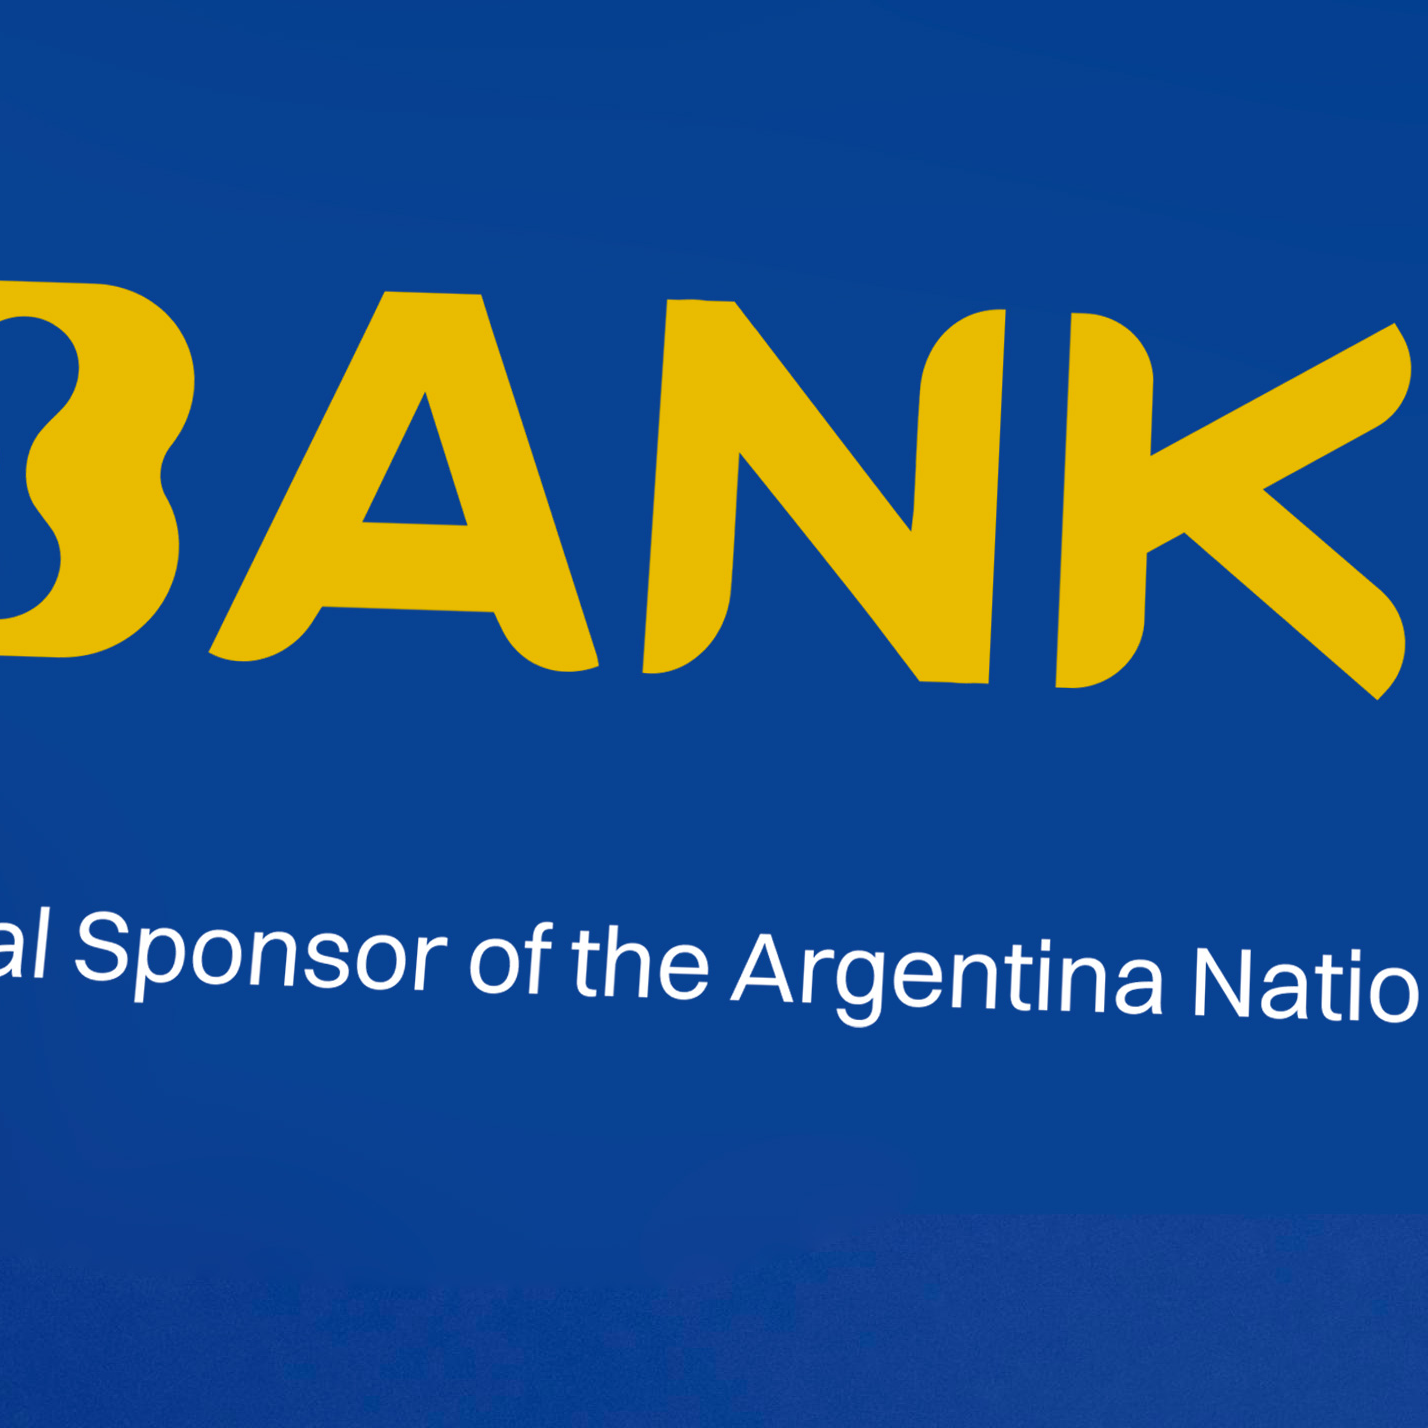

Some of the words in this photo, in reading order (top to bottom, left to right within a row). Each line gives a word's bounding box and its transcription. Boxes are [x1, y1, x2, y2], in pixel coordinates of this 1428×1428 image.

[75, 911, 448, 1003] Sponsor
[470, 922, 554, 995] of
[572, 925, 709, 1001] the
[730, 934, 1163, 1028] Argentina
